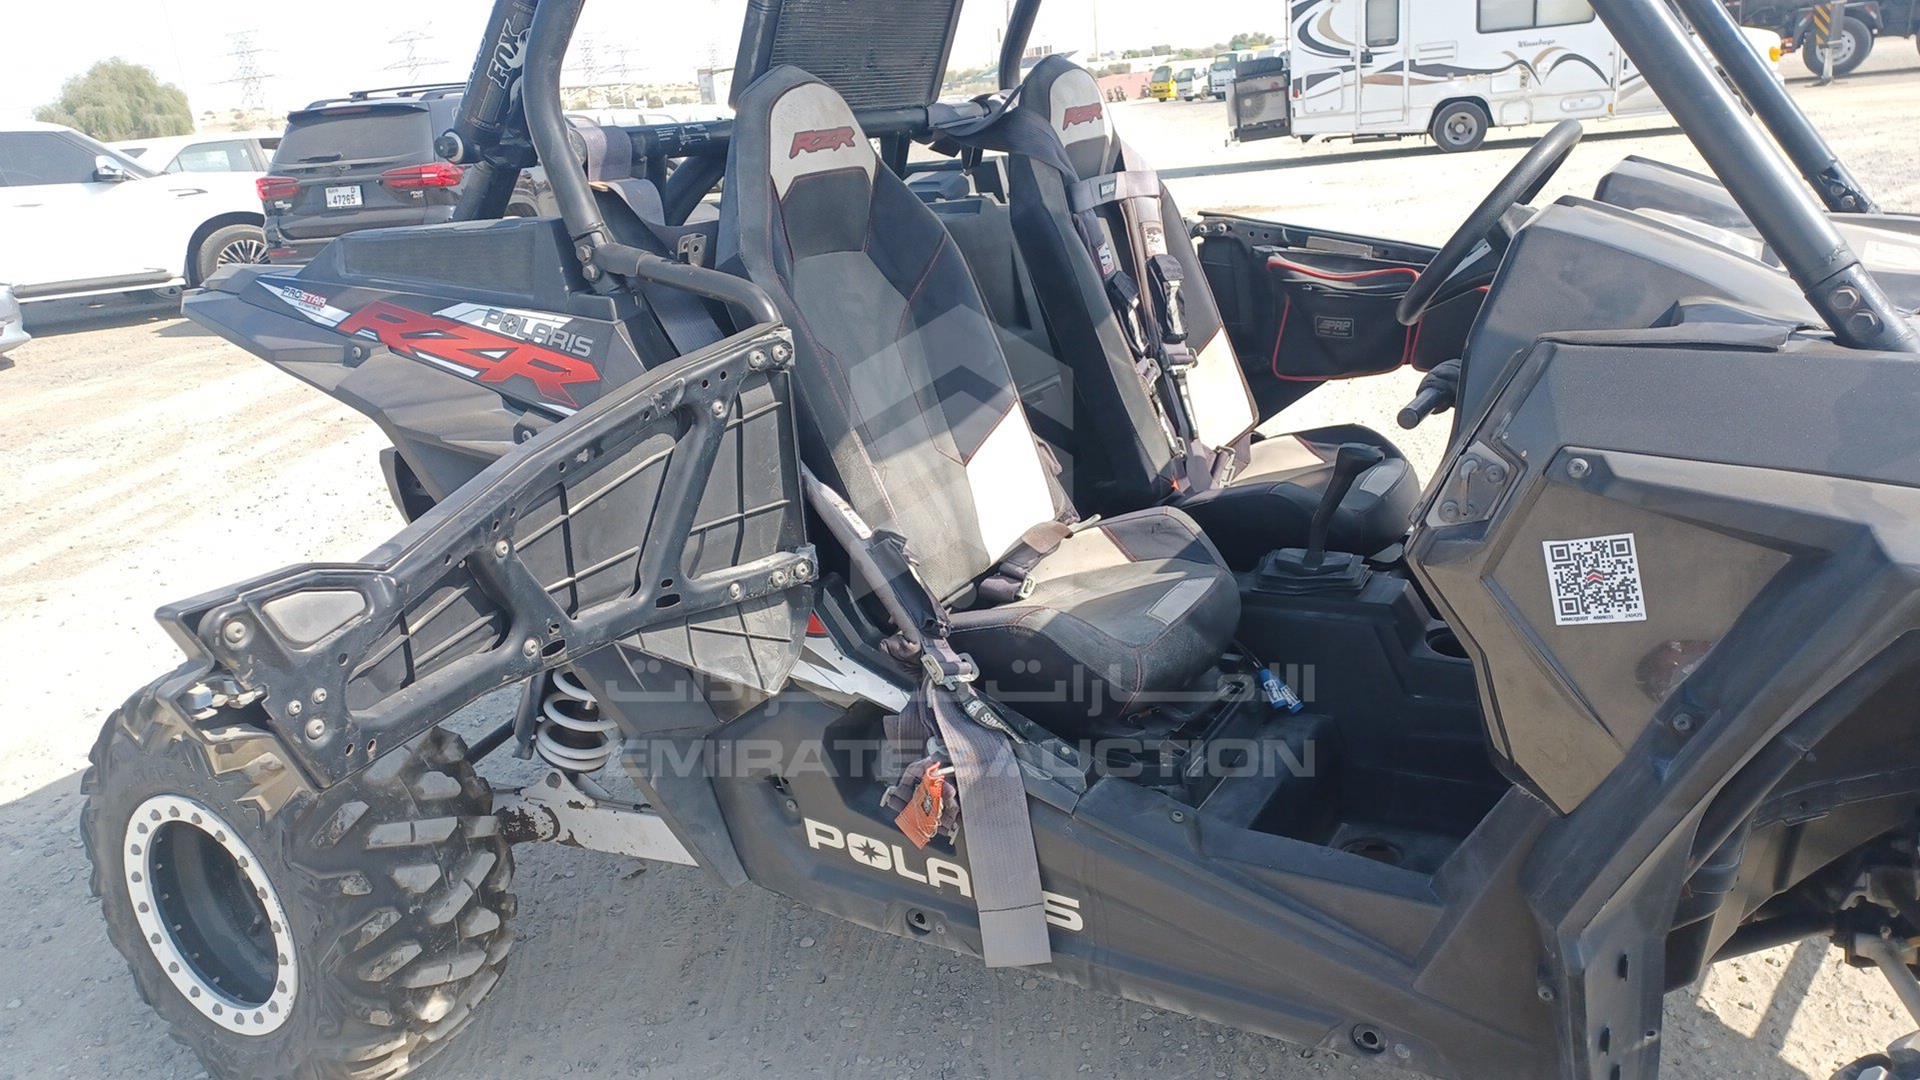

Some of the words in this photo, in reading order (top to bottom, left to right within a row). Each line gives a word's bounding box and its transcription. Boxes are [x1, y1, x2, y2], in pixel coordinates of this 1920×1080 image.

[487, 18, 521, 89] FOX
[789, 126, 856, 159] RZR
[337, 299, 601, 408] RZR
[481, 308, 594, 358] POLARIS
[804, 818, 1084, 931] POLAS
